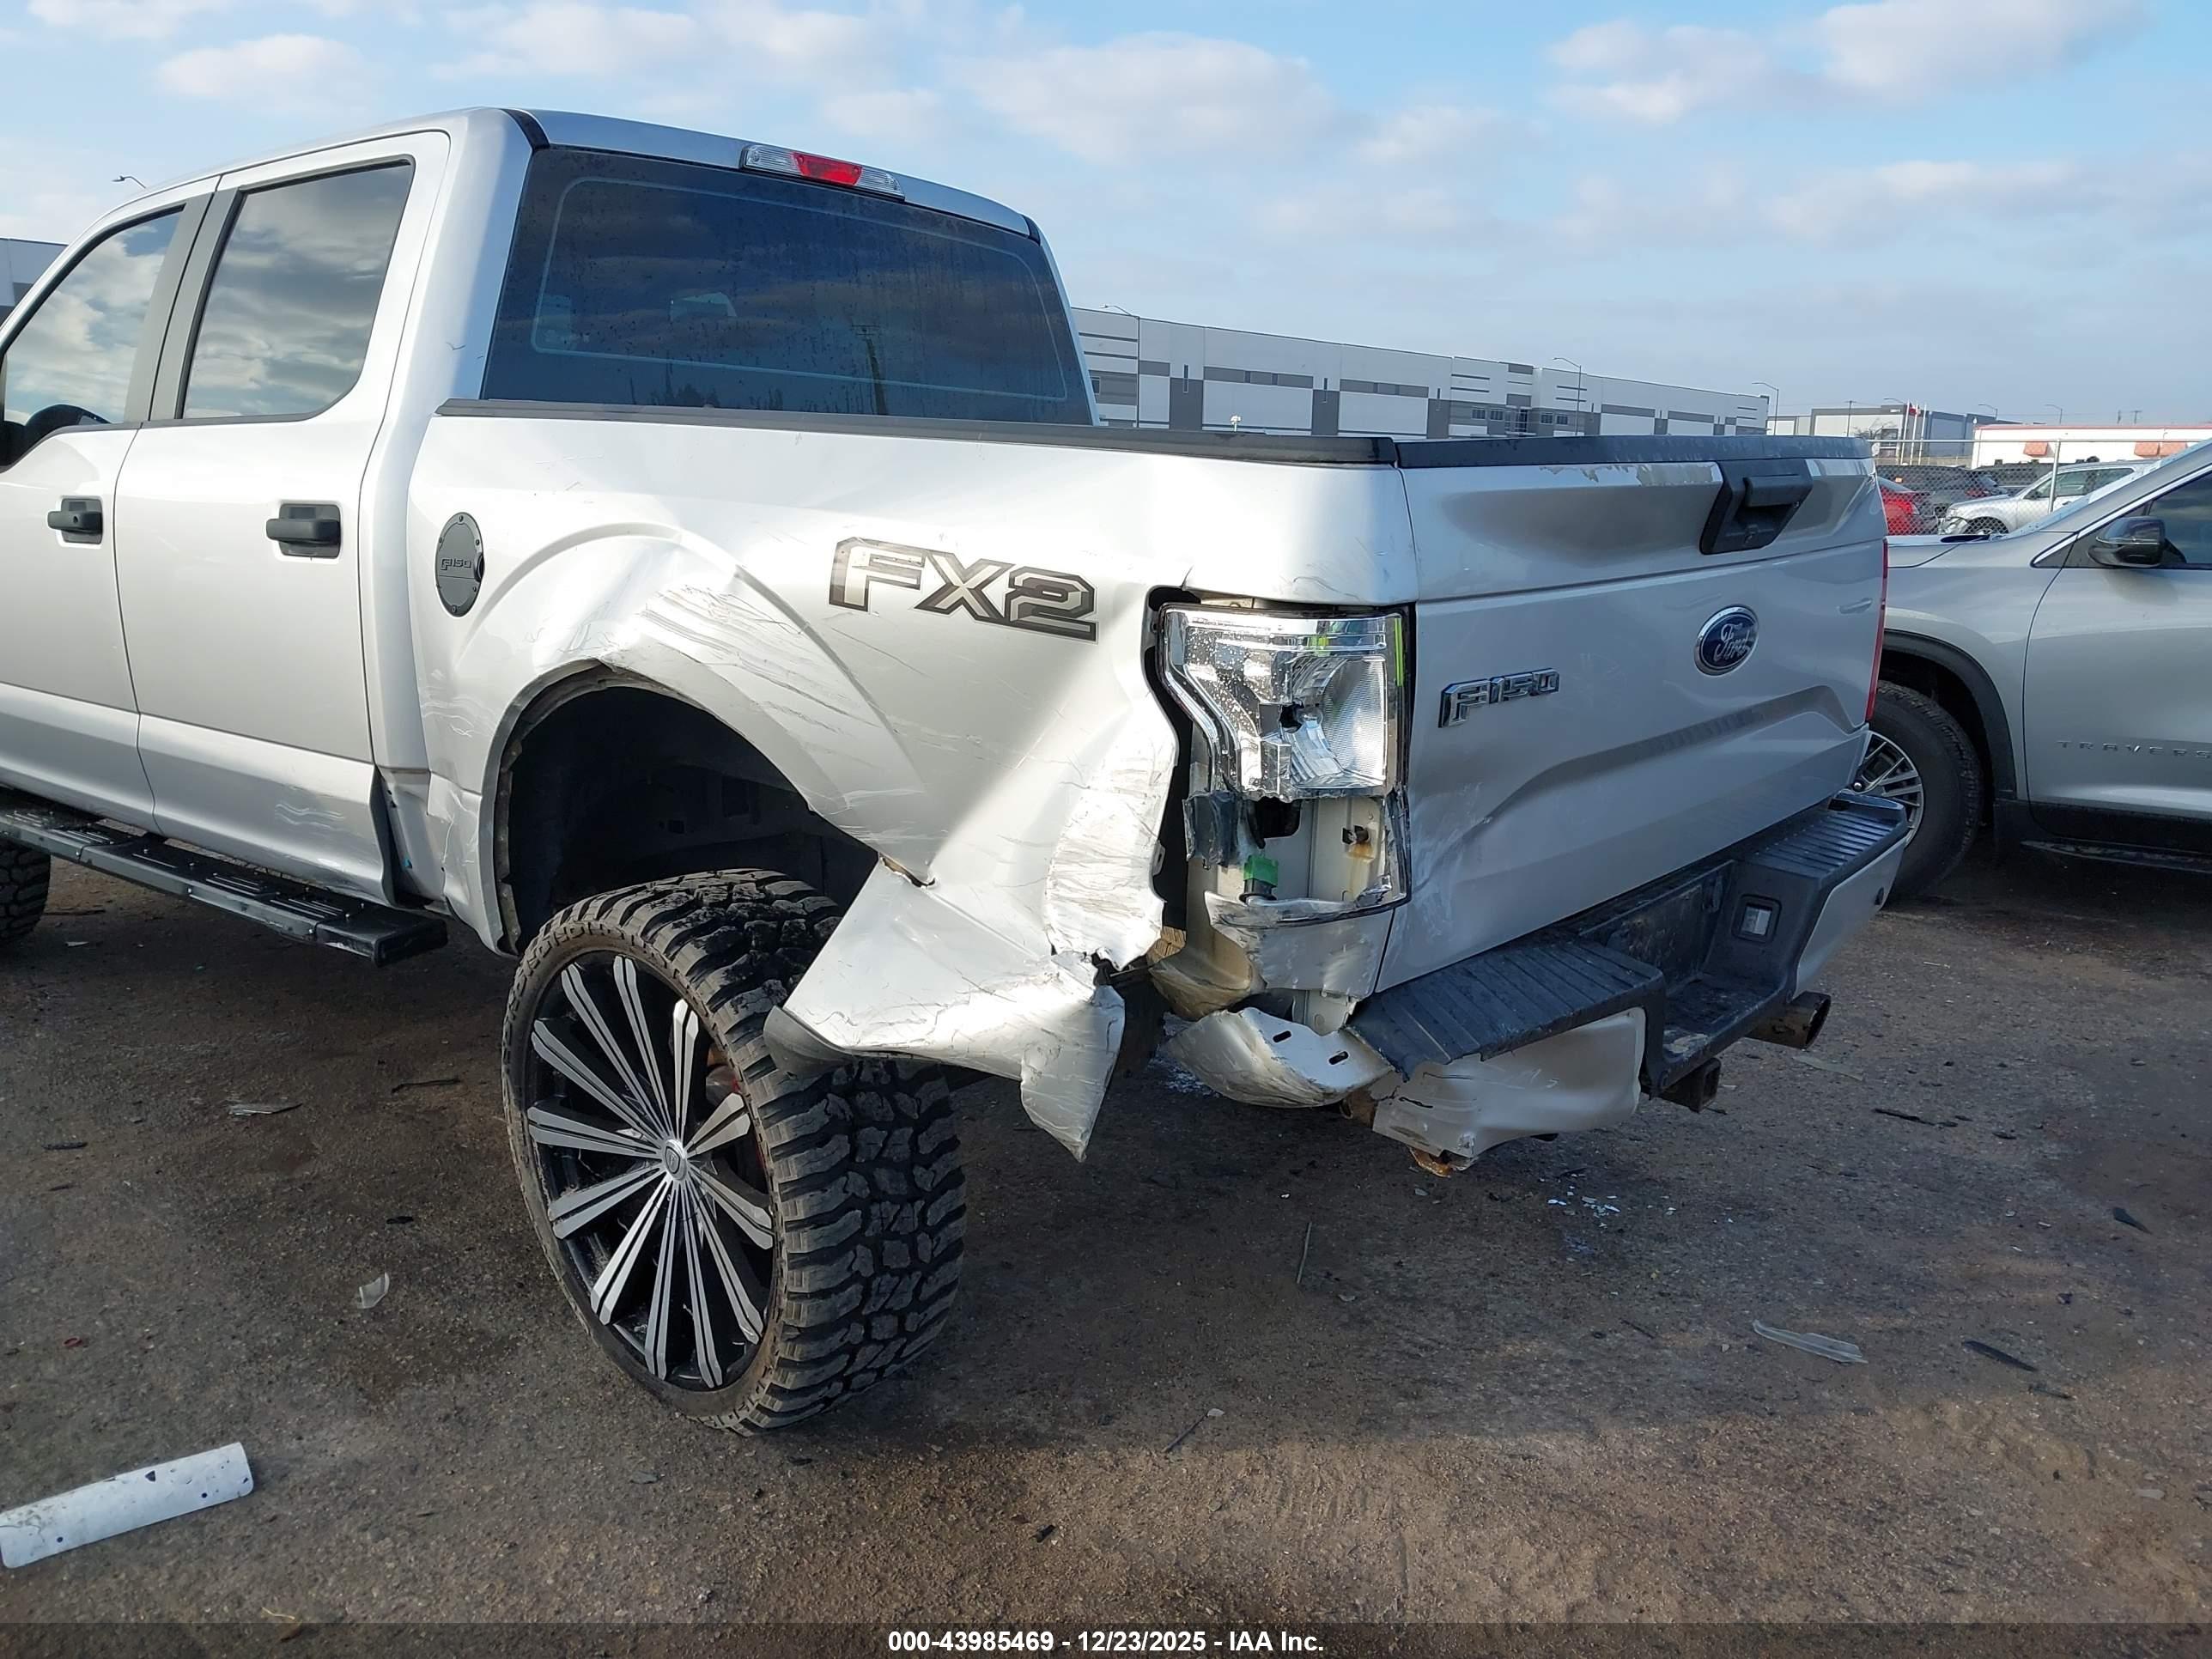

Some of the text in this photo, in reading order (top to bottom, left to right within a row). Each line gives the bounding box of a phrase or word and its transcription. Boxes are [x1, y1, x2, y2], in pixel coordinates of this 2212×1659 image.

[828, 536, 1097, 643] FX2
[1713, 623, 1751, 661] Ford
[1437, 667, 1560, 729] F150
